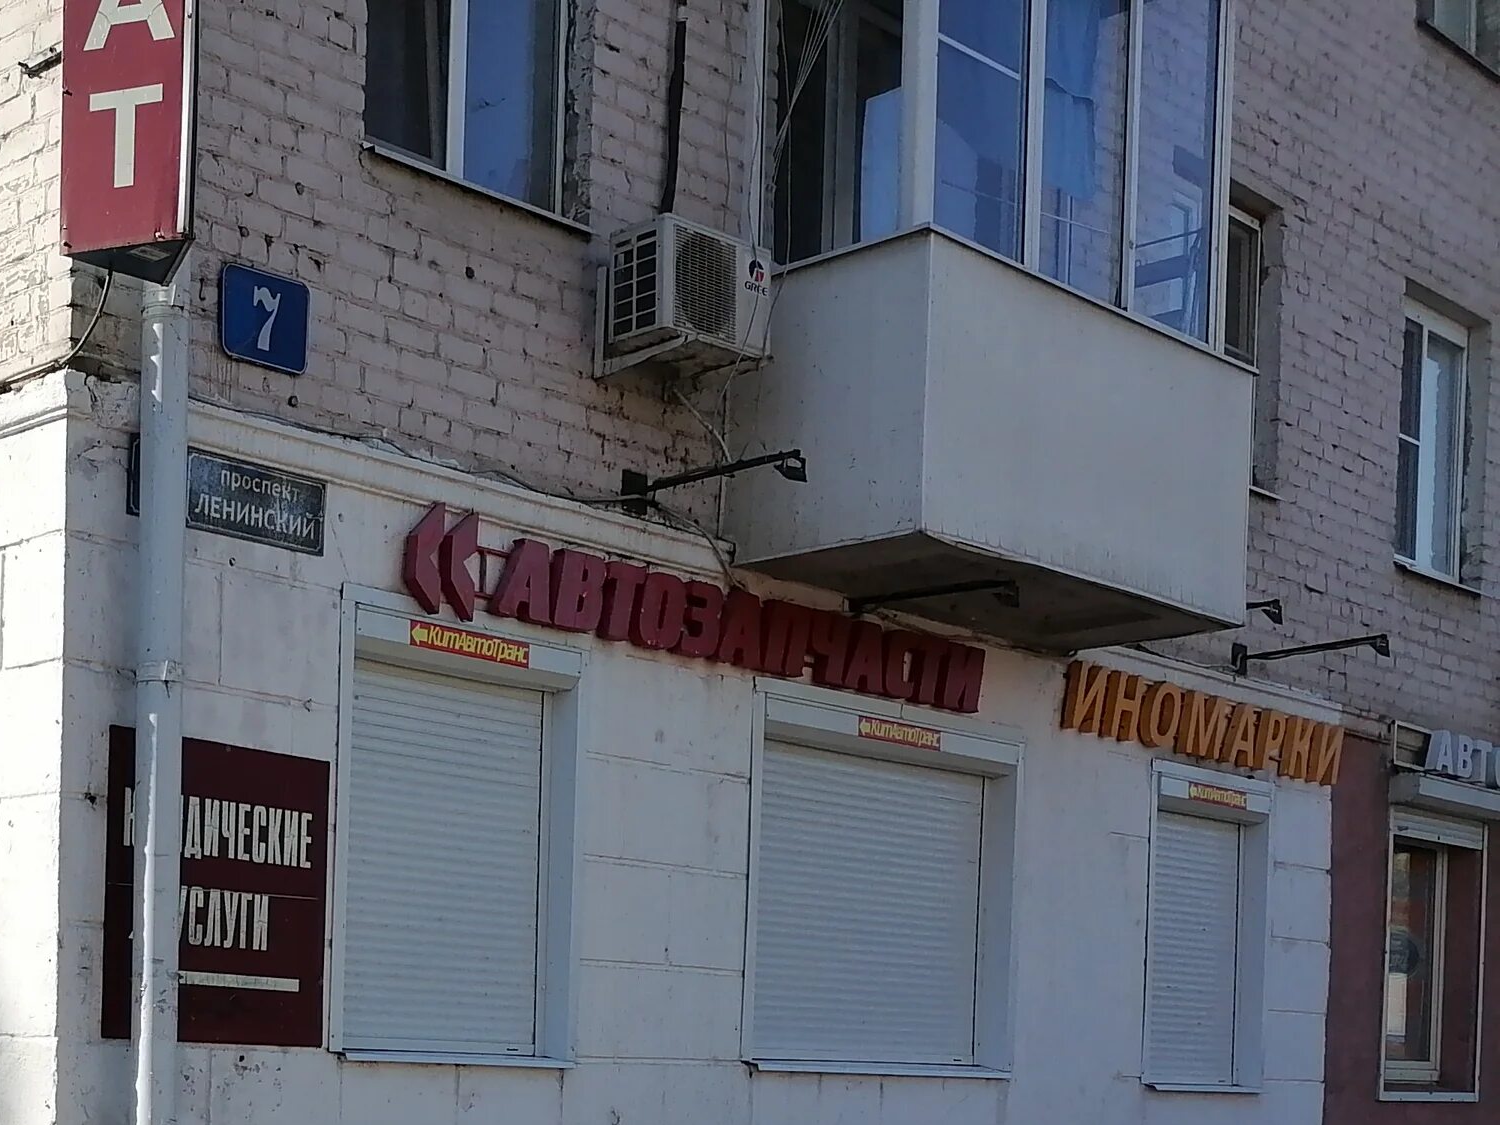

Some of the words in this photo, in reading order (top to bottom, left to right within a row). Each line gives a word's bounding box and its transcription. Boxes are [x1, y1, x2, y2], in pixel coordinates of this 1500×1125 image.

[253, 285, 281, 351] 7
[194, 493, 316, 540] ЛЕНИНСКИЙ
[220, 469, 301, 502] проспект
[427, 625, 529, 662] КитАвтоТранс
[491, 538, 986, 713] АВТОЗАПЧАСТИ
[1062, 660, 1346, 786] ИНОМАРКИ
[1431, 730, 1500, 789] АВТ
[124, 786, 314, 869] ДИЧЕСКИЕ
